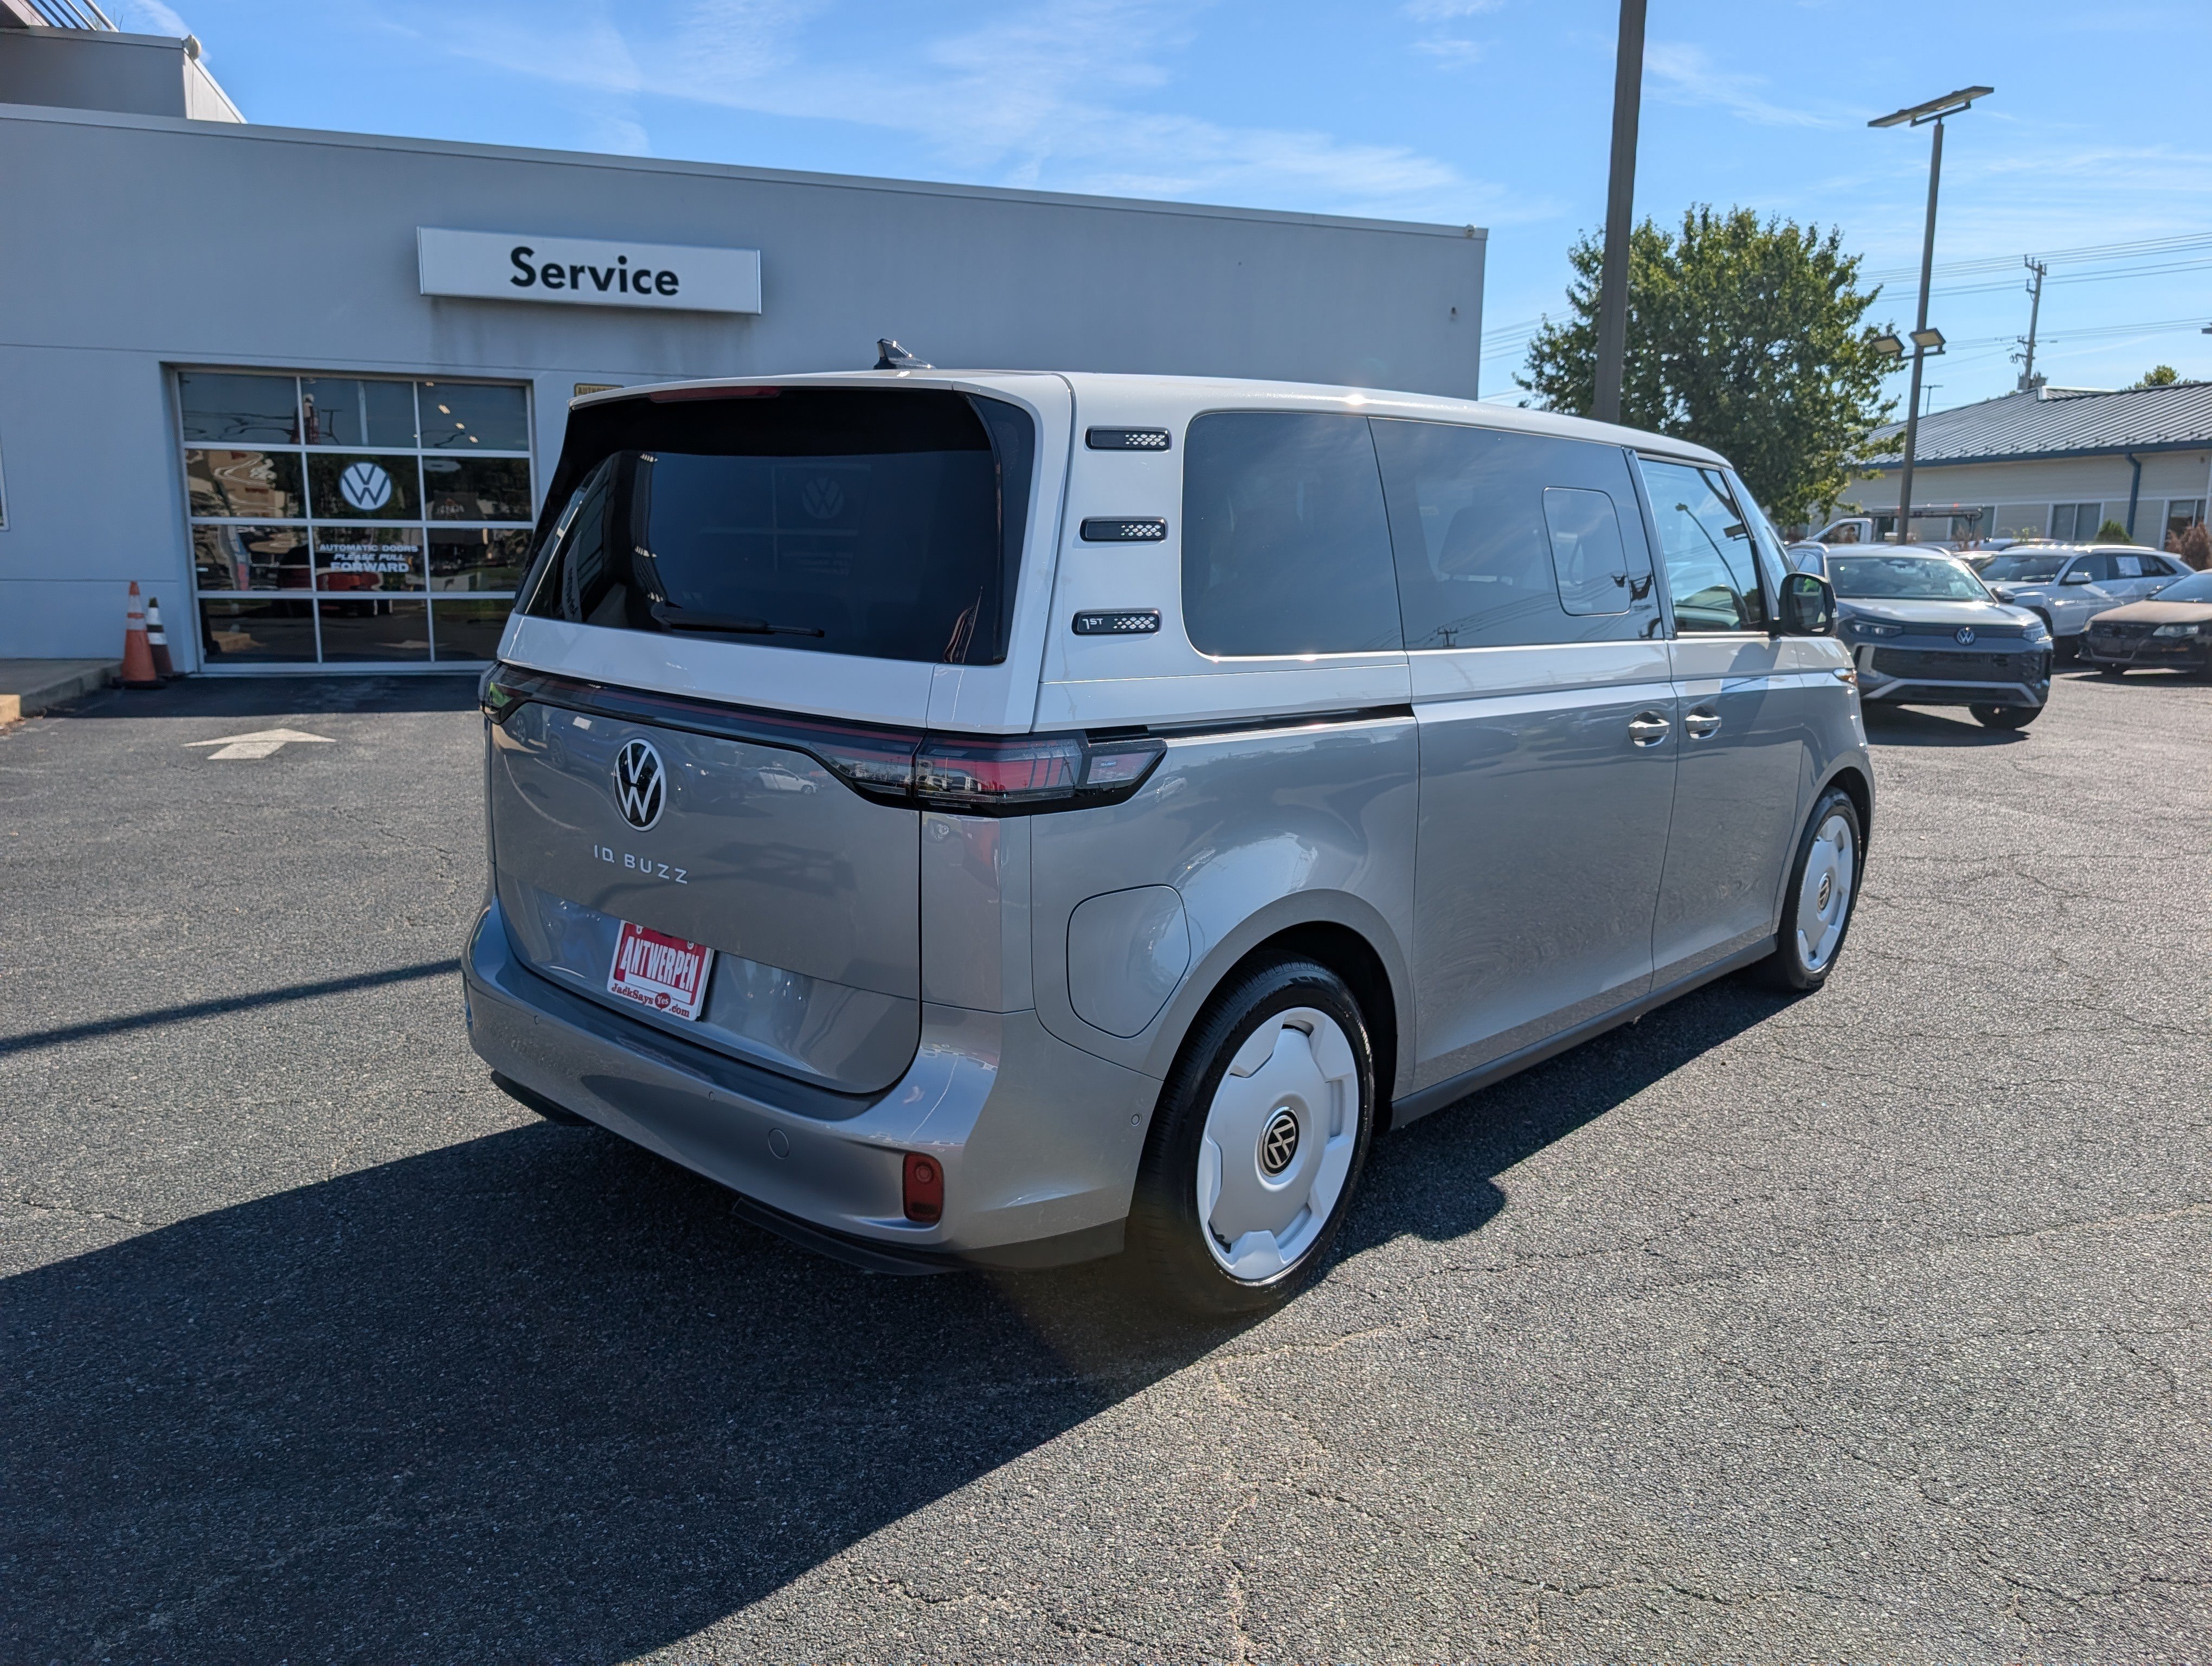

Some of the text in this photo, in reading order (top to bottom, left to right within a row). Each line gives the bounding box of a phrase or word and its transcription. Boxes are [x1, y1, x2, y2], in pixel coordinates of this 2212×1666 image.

[510, 246, 679, 296] Service
[341, 462, 391, 510] VW
[331, 561, 409, 572] FORWARD
[1082, 618, 1103, 629] 1ST
[614, 738, 667, 831] VW
[625, 854, 687, 884] BUZZ
[619, 936, 699, 992] ANTWERPEN
